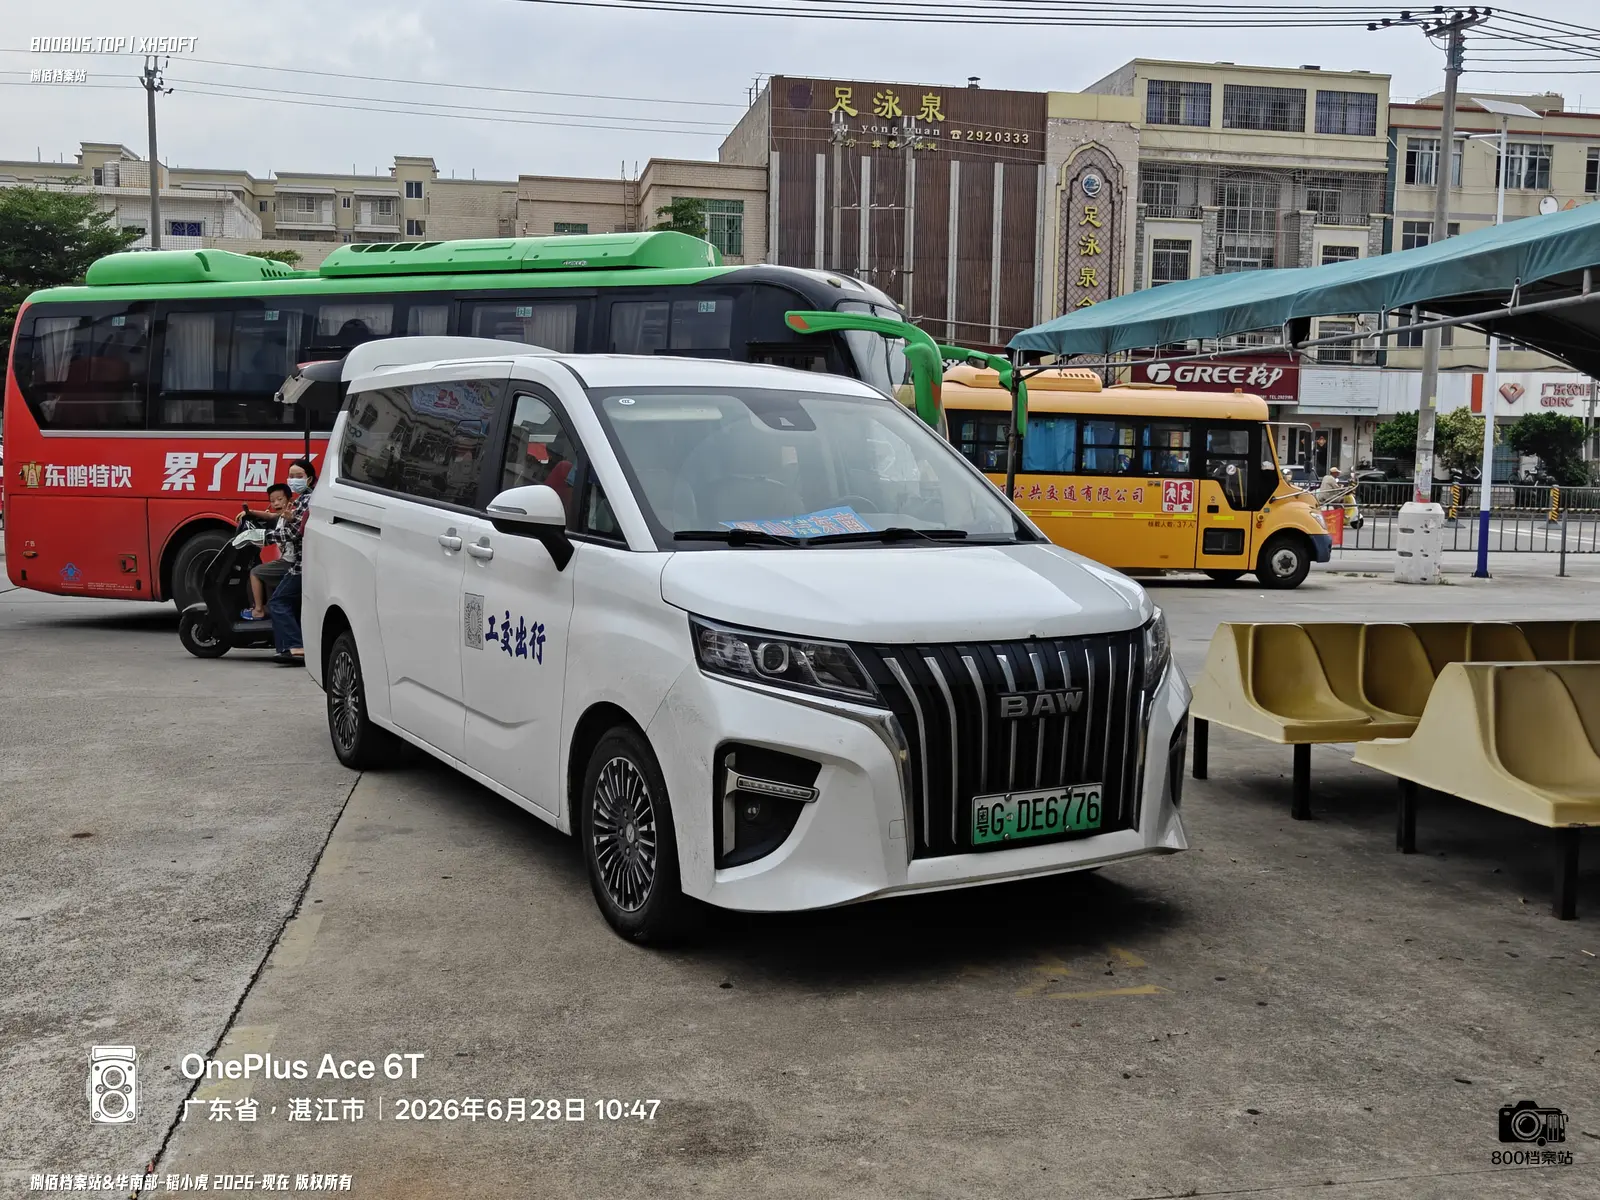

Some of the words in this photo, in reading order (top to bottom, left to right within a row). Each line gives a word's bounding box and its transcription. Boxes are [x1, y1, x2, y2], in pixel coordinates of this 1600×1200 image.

[829, 86, 945, 123] 足泳泉
[861, 124, 898, 136] yong
[966, 130, 1029, 144] 2920333
[1174, 366, 1246, 384] GREE
[1540, 396, 1574, 407] GDRC
[45, 463, 132, 489] 东鹏特饮
[1000, 484, 1145, 504] 公共交通有限公司
[1000, 691, 1084, 718] BAW
